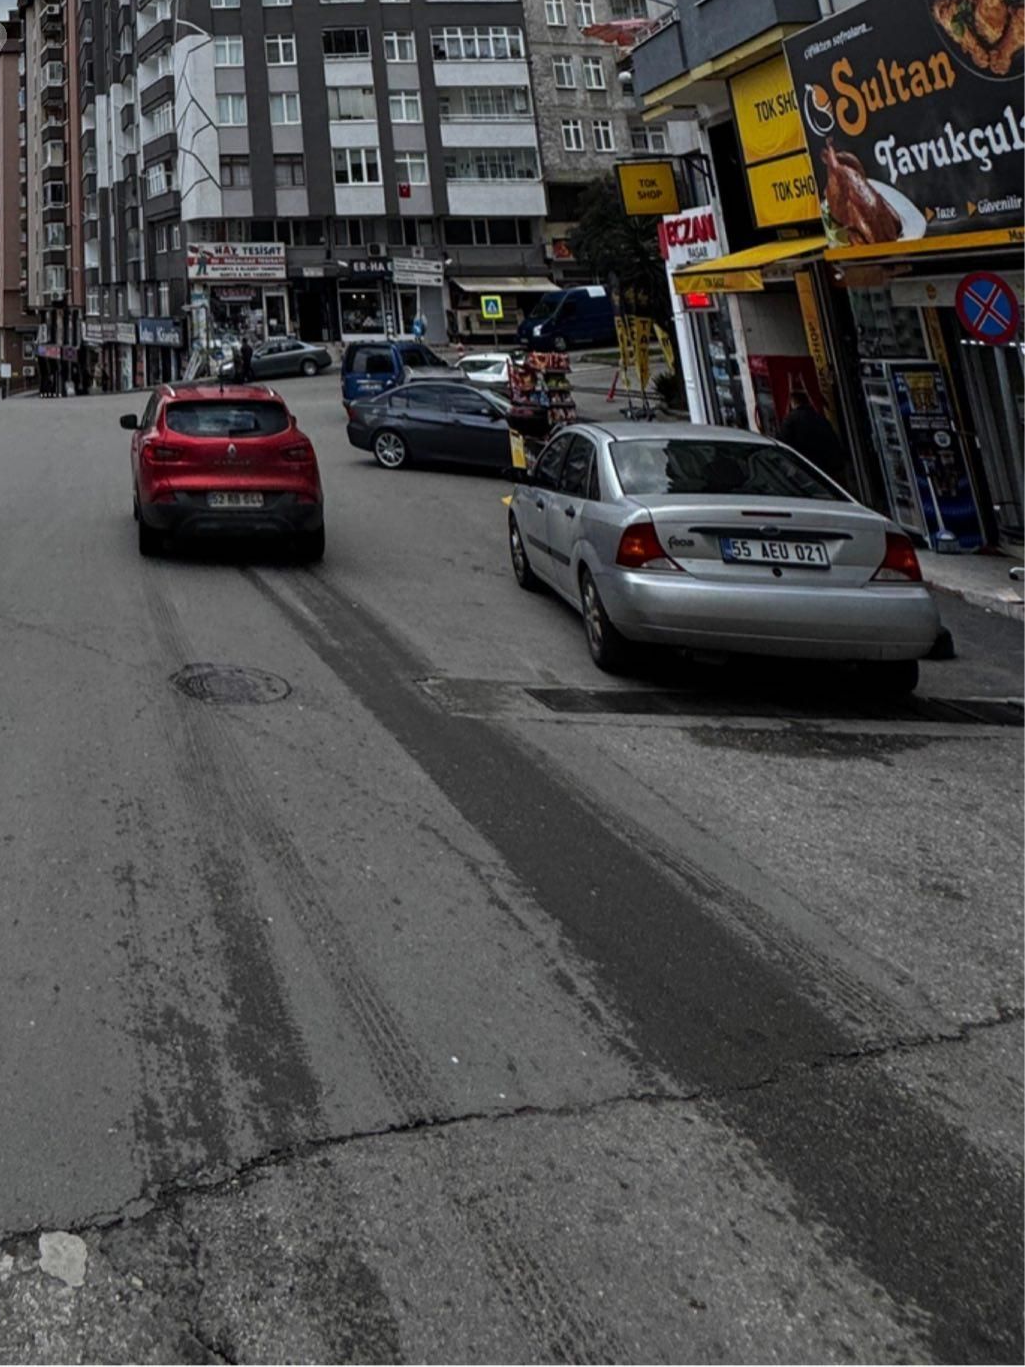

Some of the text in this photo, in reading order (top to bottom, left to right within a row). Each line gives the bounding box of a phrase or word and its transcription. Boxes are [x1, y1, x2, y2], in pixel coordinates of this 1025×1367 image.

[831, 50, 956, 136] Sultan
[754, 90, 798, 123] TOK SHO
[874, 105, 1024, 184] Tavukçul
[637, 190, 663, 200] SHOP
[638, 178, 658, 188] TOK
[772, 175, 816, 202] TOK SHO
[935, 195, 1023, 219] Taze Güvenilir
[732, 540, 824, 562] 55 AEU 021
